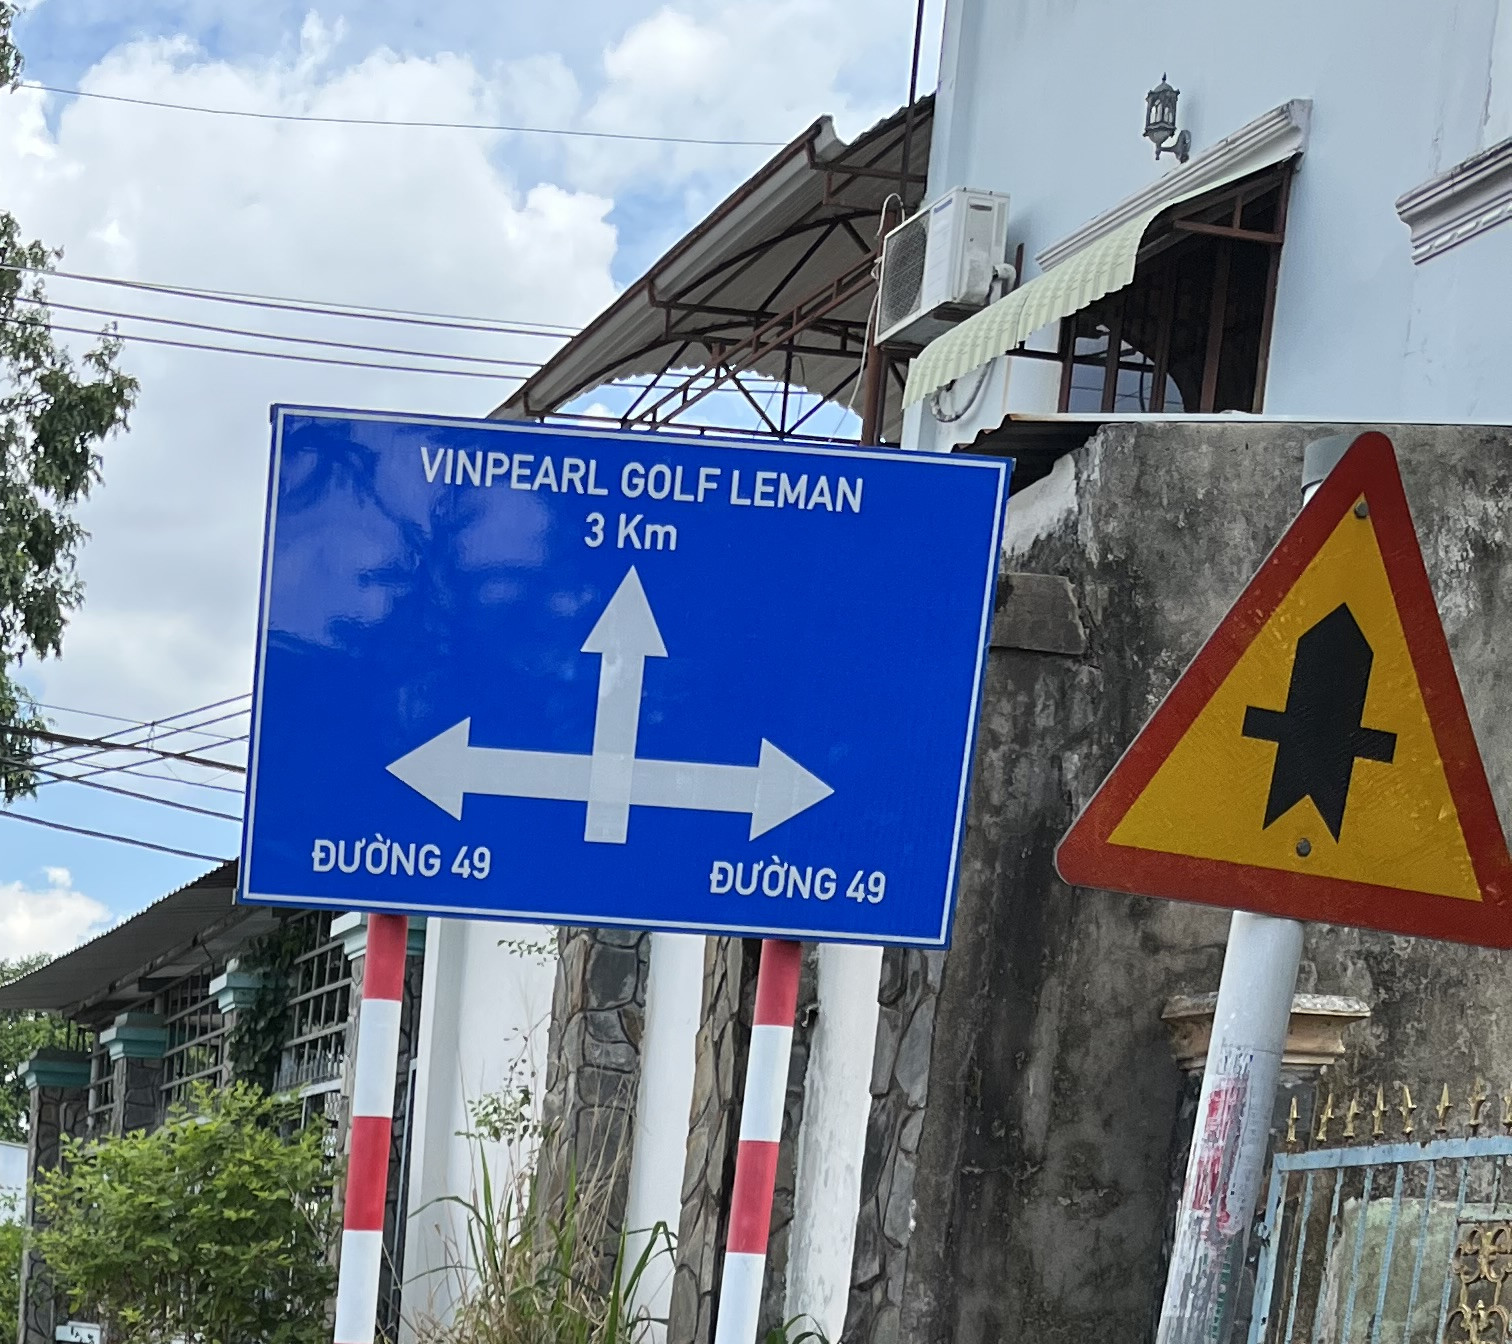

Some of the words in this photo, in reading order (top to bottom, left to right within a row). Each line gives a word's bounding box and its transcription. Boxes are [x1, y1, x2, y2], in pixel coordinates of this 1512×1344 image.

[420, 446, 609, 496] VINPEARL
[621, 462, 721, 503] GOLF
[730, 469, 863, 513] LEMAN
[584, 512, 605, 549] 3
[617, 513, 677, 551] Km
[311, 834, 441, 877] ĐƯỜNG
[451, 846, 491, 880] 49
[709, 855, 837, 901] ĐƯỜNG
[845, 870, 886, 904] 49
